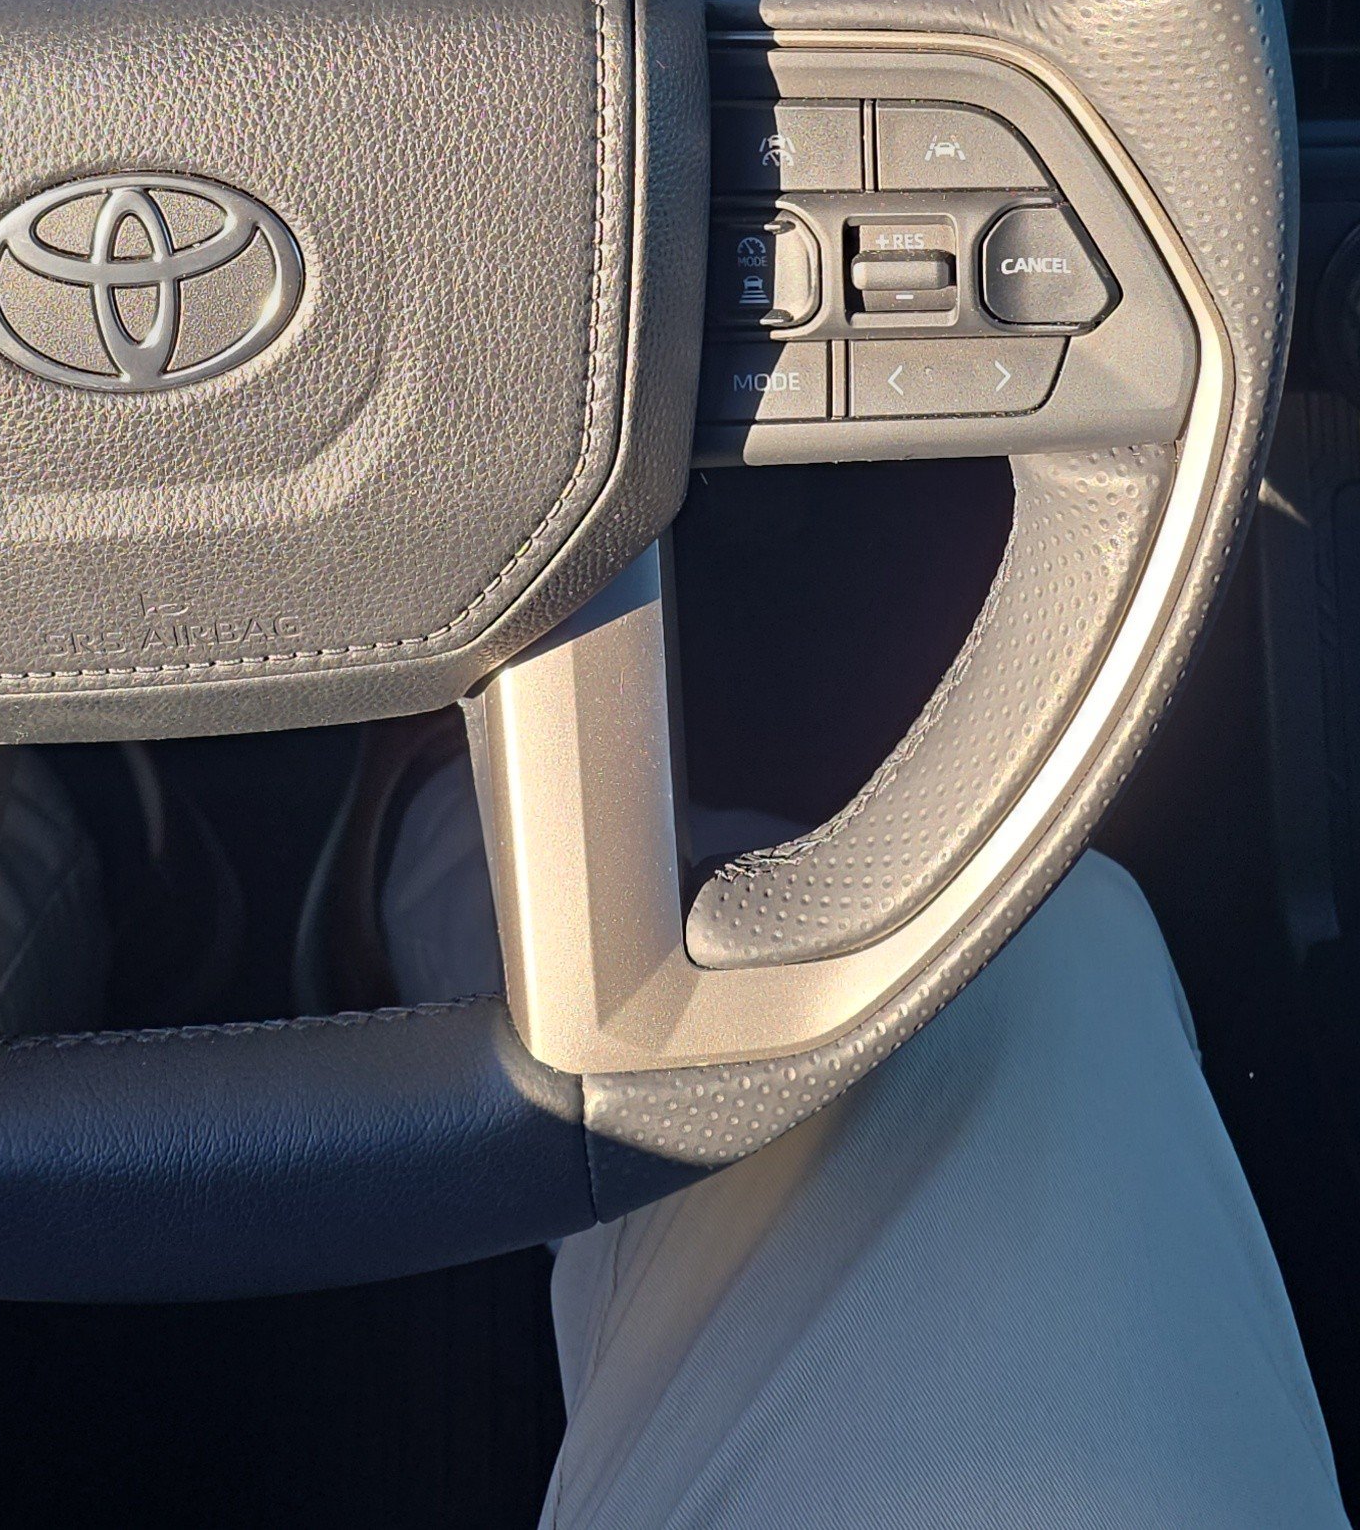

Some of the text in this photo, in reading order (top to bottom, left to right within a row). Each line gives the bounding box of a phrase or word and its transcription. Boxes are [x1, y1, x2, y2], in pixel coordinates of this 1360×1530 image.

[738, 257, 768, 267] MODE
[1001, 258, 1071, 275] CANCEL
[734, 373, 801, 391] MODE
[143, 617, 300, 648] AIRBAG
[44, 632, 126, 656] SRS
